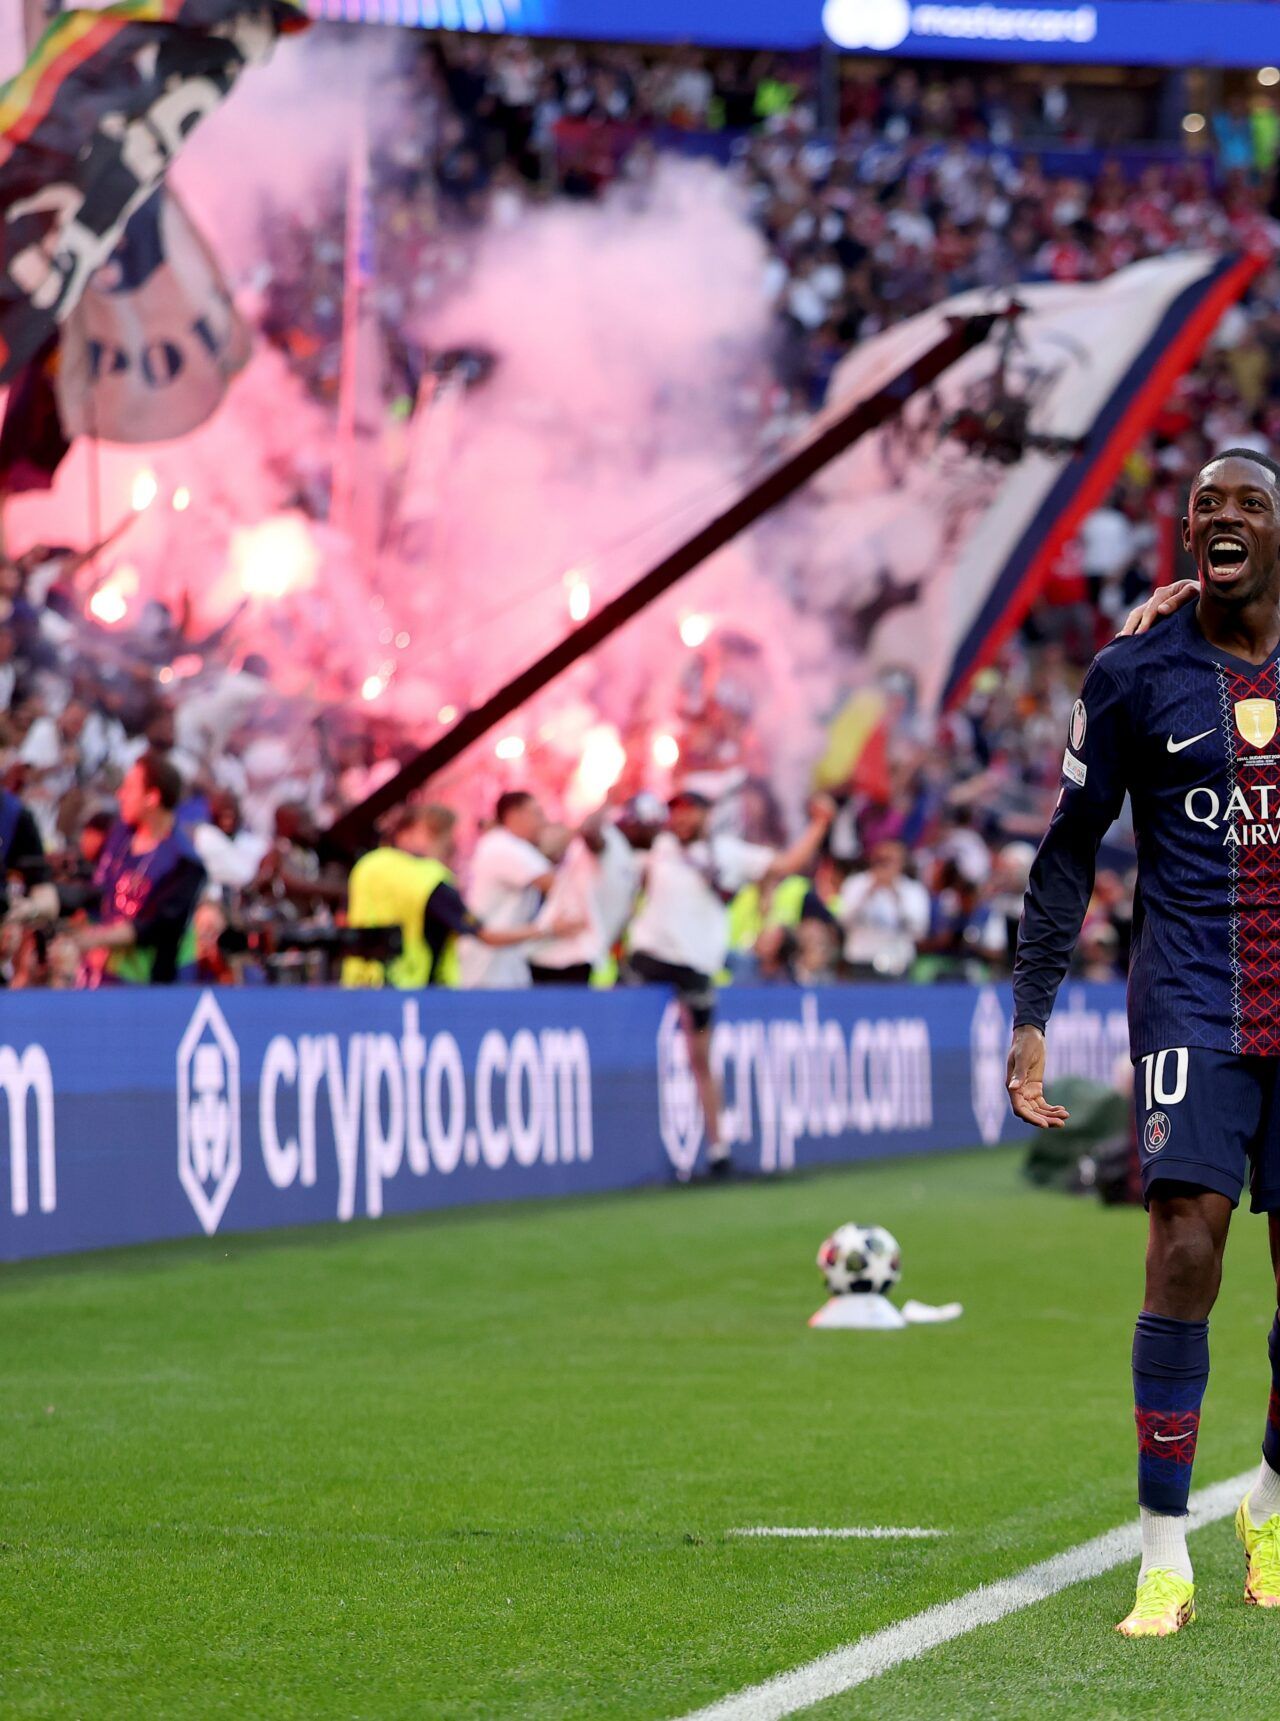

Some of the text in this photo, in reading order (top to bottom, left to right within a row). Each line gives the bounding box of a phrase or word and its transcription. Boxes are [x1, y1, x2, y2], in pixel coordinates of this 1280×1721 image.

[911, 3, 1097, 43] mastercard
[258, 999, 594, 1222] crypto.com
[1141, 1047, 1189, 1111] 10
